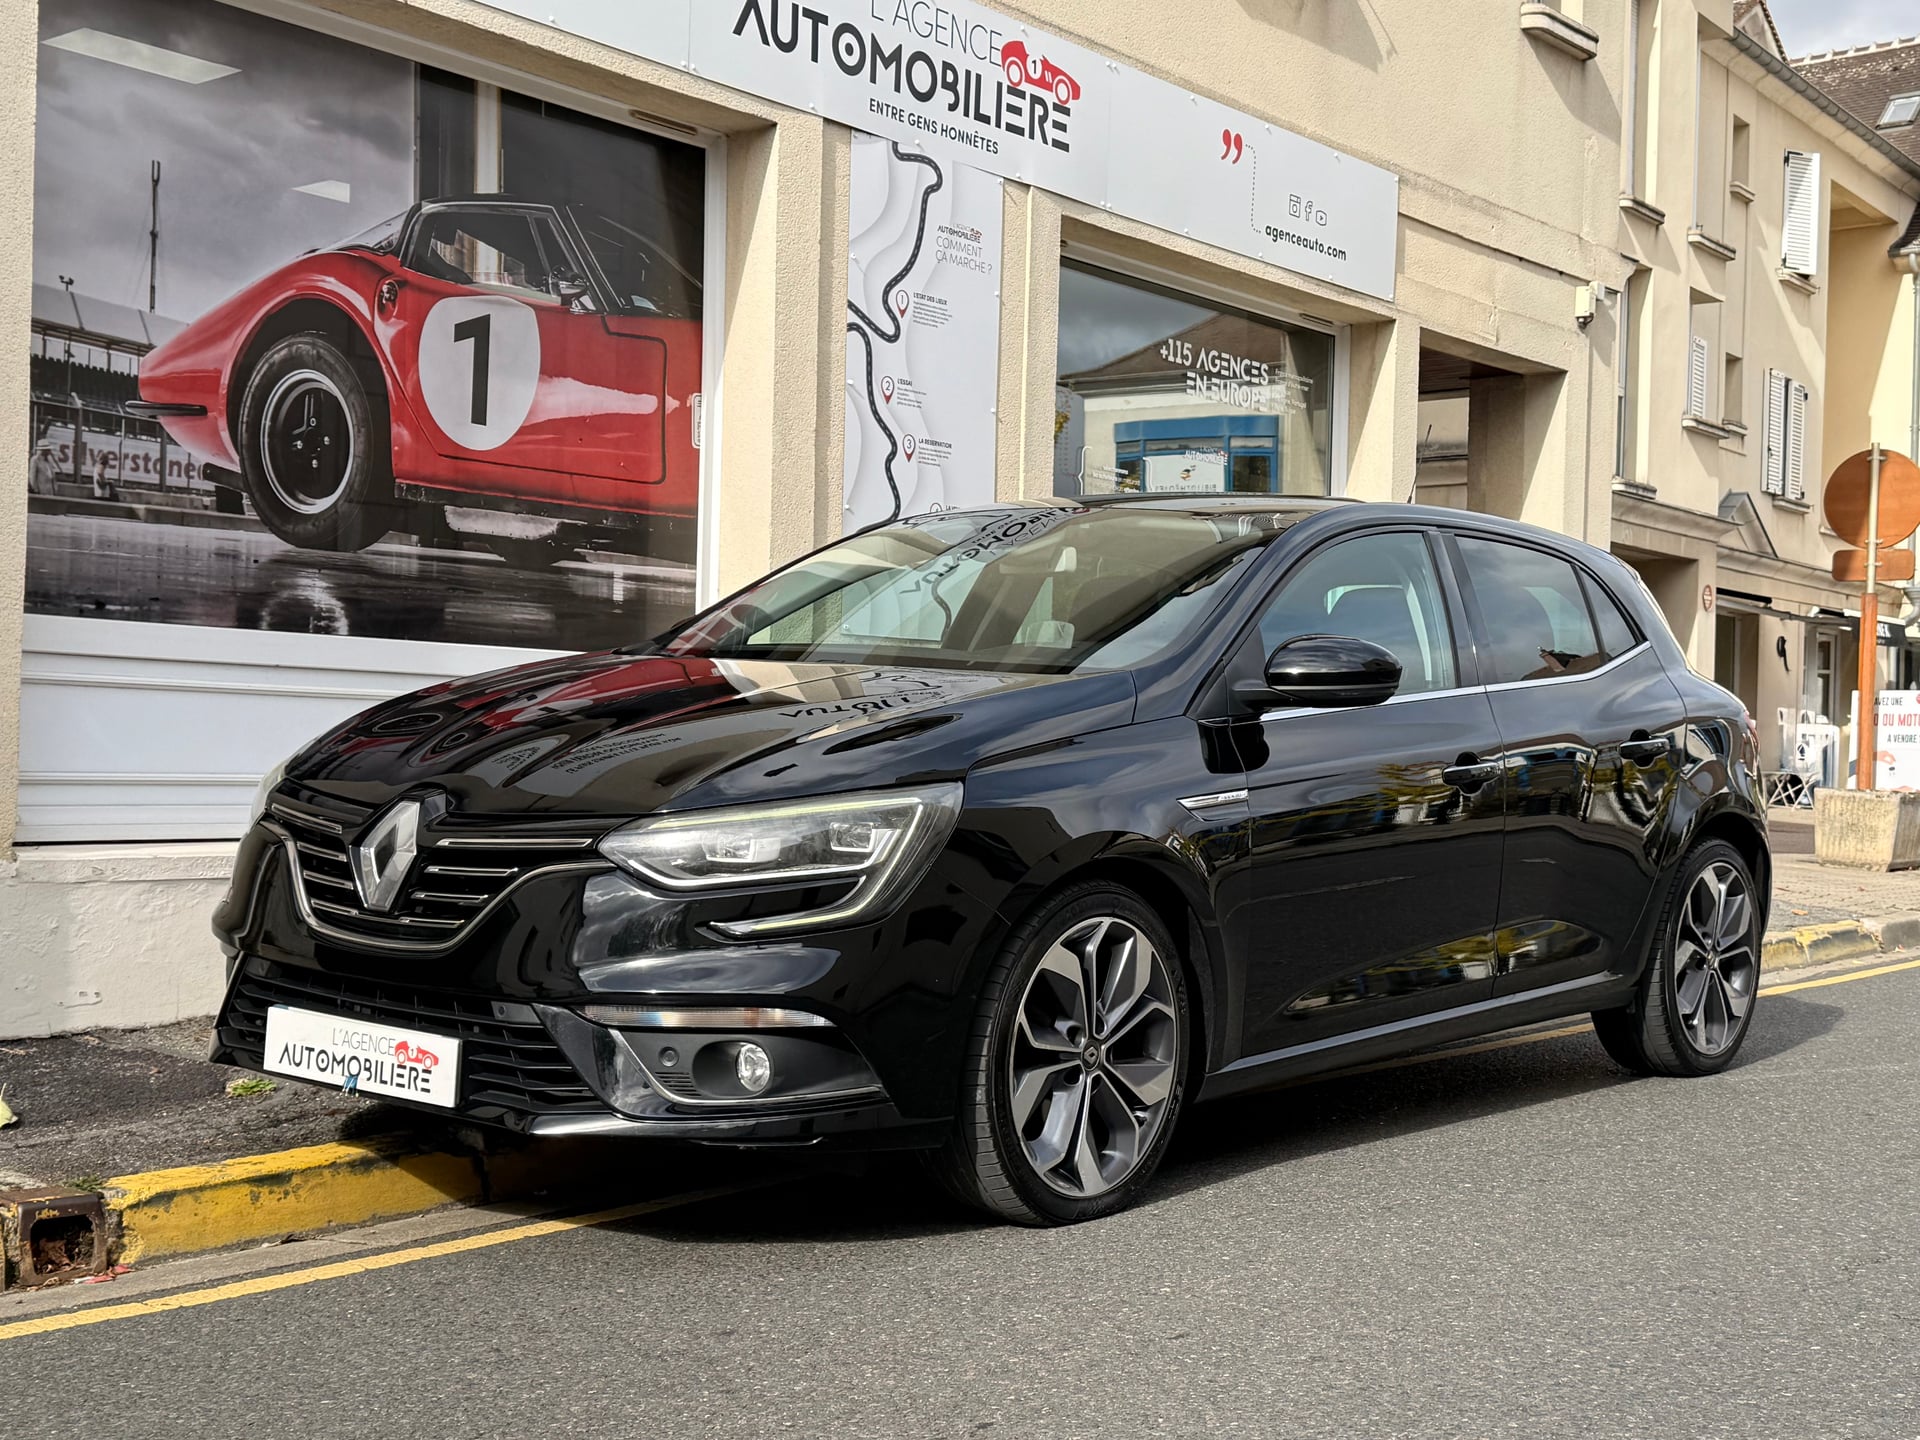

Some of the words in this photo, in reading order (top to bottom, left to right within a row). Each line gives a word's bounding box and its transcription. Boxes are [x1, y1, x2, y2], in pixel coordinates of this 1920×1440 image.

[871, 0, 1002, 66] LAGENCE
[869, 98, 905, 123] ENTRE
[908, 112, 938, 134] GENS
[941, 124, 999, 155] HONNÊTES
[936, 236, 983, 258] COMMENT
[1265, 225, 1347, 261] agenceauto.com
[935, 249, 948, 264] ÇA
[949, 253, 986, 274] MARCHE
[454, 314, 491, 427] 1
[1160, 338, 1193, 366] +115
[1196, 348, 1269, 385] AGENCES
[1186, 372, 1206, 398] EN
[1891, 697, 1903, 706] UNE
[1883, 713, 1894, 726] OU
[1893, 734, 1917, 743] VENDRE
[332, 1027, 396, 1056] L'AGENCE
